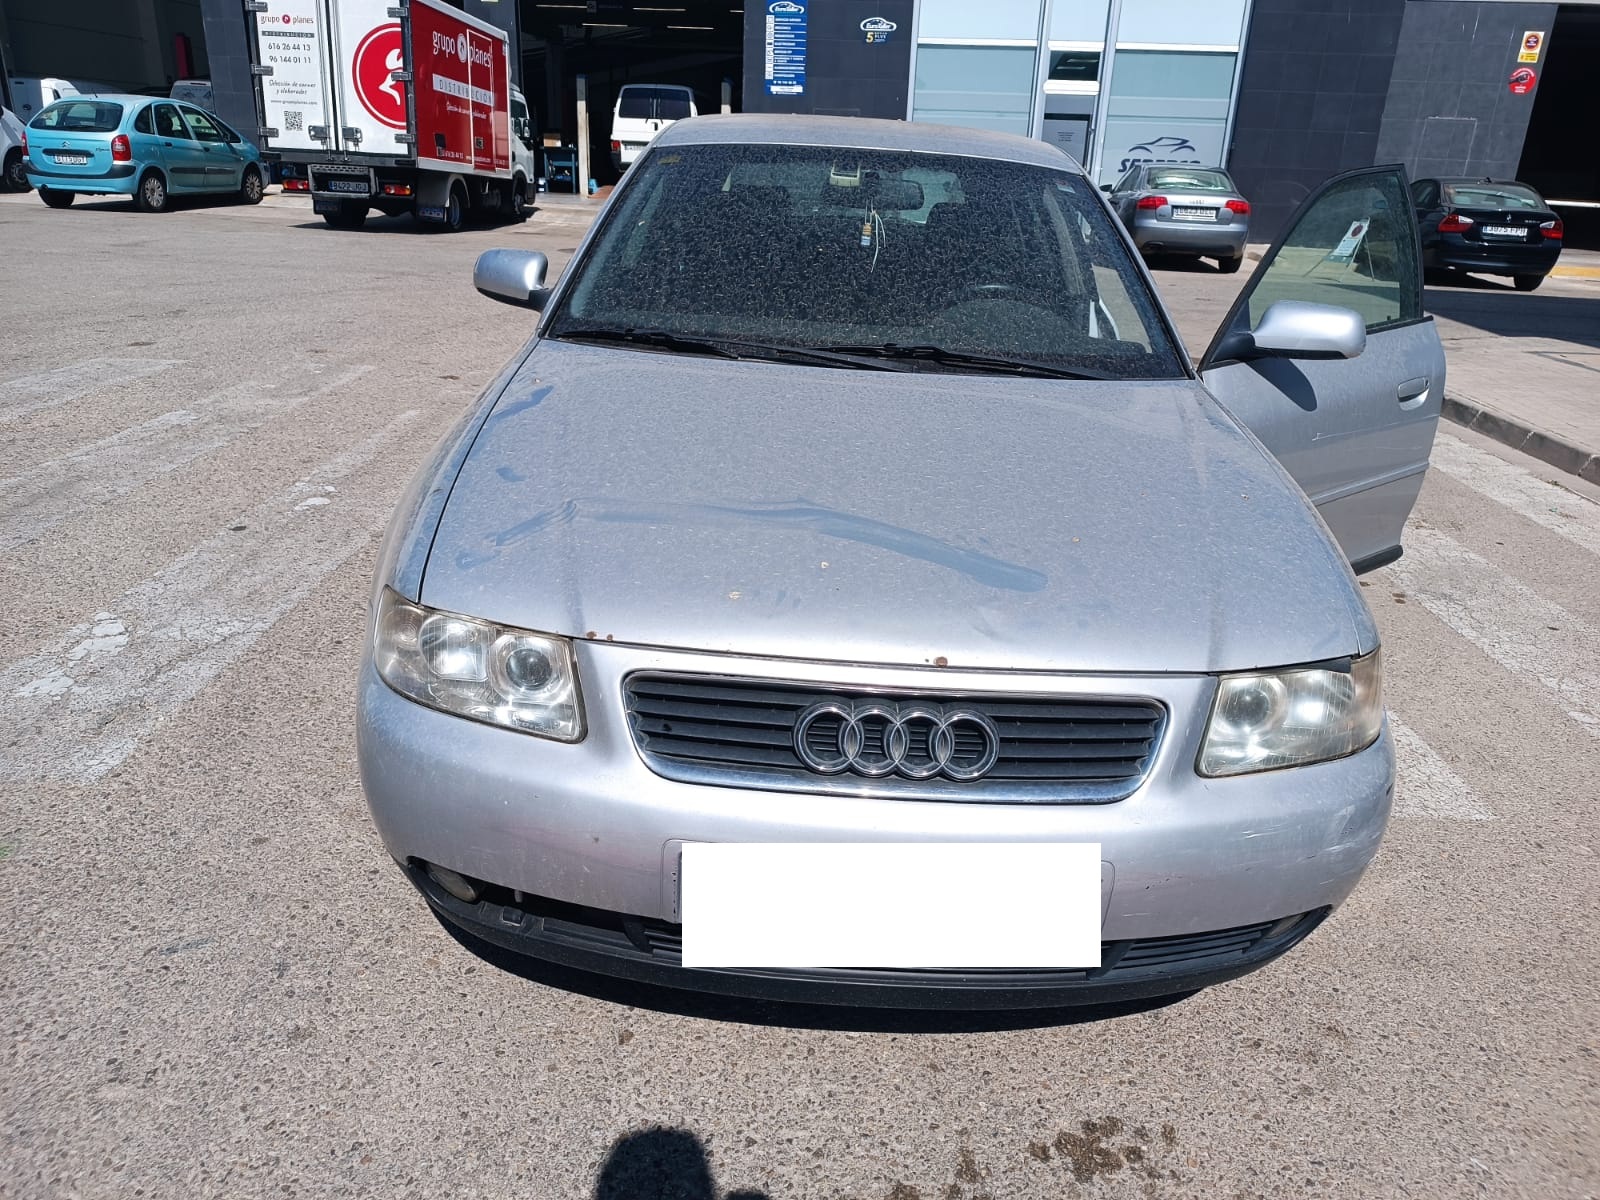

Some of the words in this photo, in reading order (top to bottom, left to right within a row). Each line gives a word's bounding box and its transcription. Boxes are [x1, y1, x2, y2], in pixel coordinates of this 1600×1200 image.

[260, 15, 280, 24] grupo
[292, 15, 314, 24] planes
[866, 32, 874, 43] 5
[432, 31, 456, 58] grupo
[469, 41, 492, 68] planes
